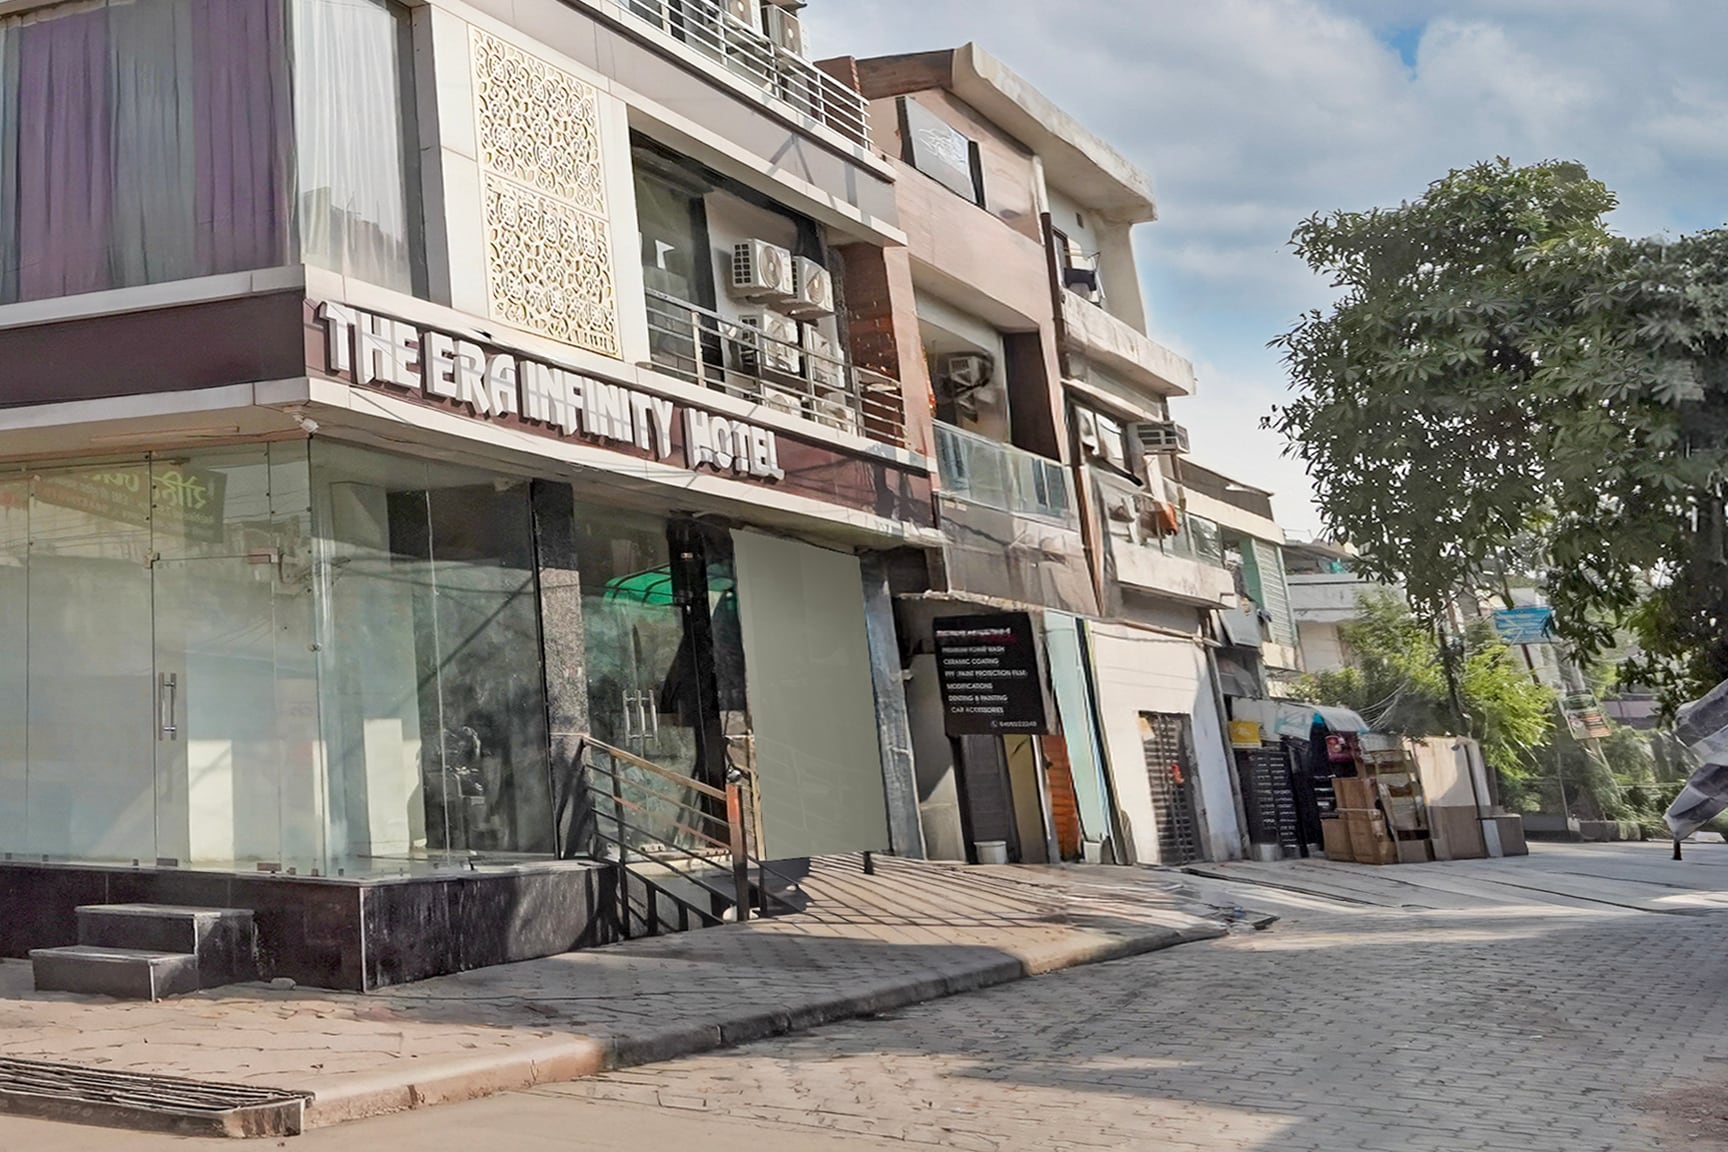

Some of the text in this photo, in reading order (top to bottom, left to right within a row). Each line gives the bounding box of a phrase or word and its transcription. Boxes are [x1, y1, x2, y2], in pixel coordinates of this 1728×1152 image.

[319, 301, 786, 481] THE ERA INFINITY HOTEL
